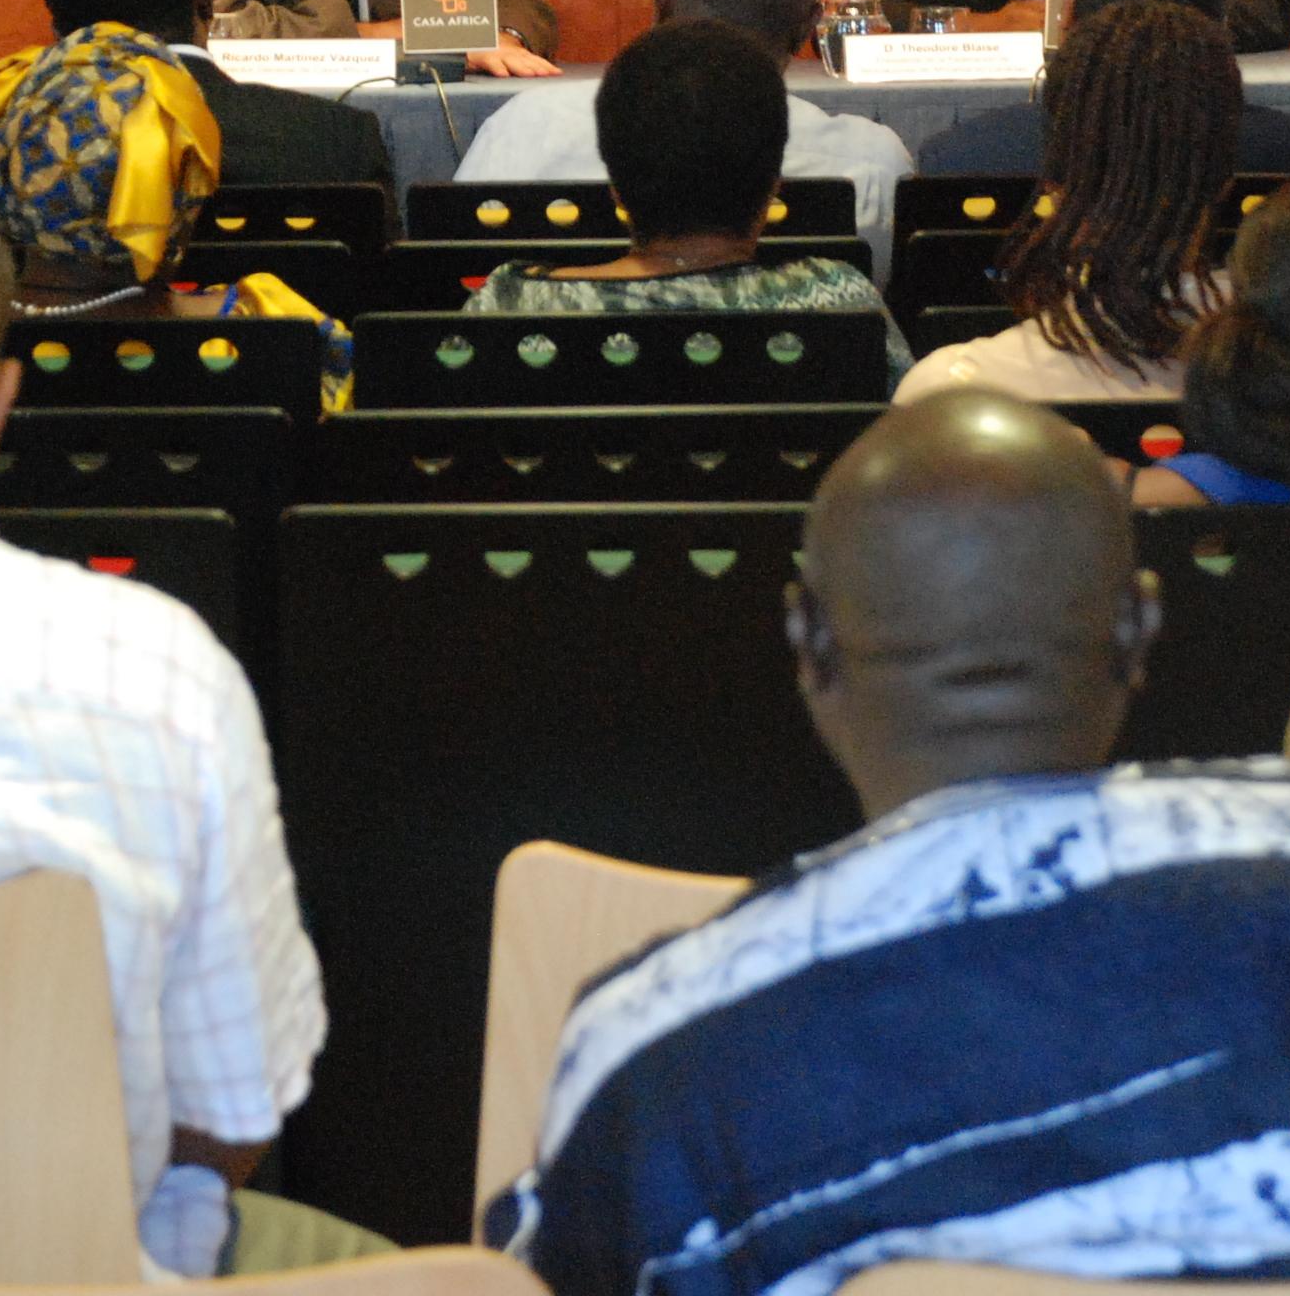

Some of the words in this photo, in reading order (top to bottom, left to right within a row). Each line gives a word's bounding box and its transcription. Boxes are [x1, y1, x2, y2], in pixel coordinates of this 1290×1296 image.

[412, 16, 445, 28] CASA
[447, 15, 490, 27] AFRICA
[900, 43, 959, 53] Theodore
[222, 52, 269, 62] Ricardo
